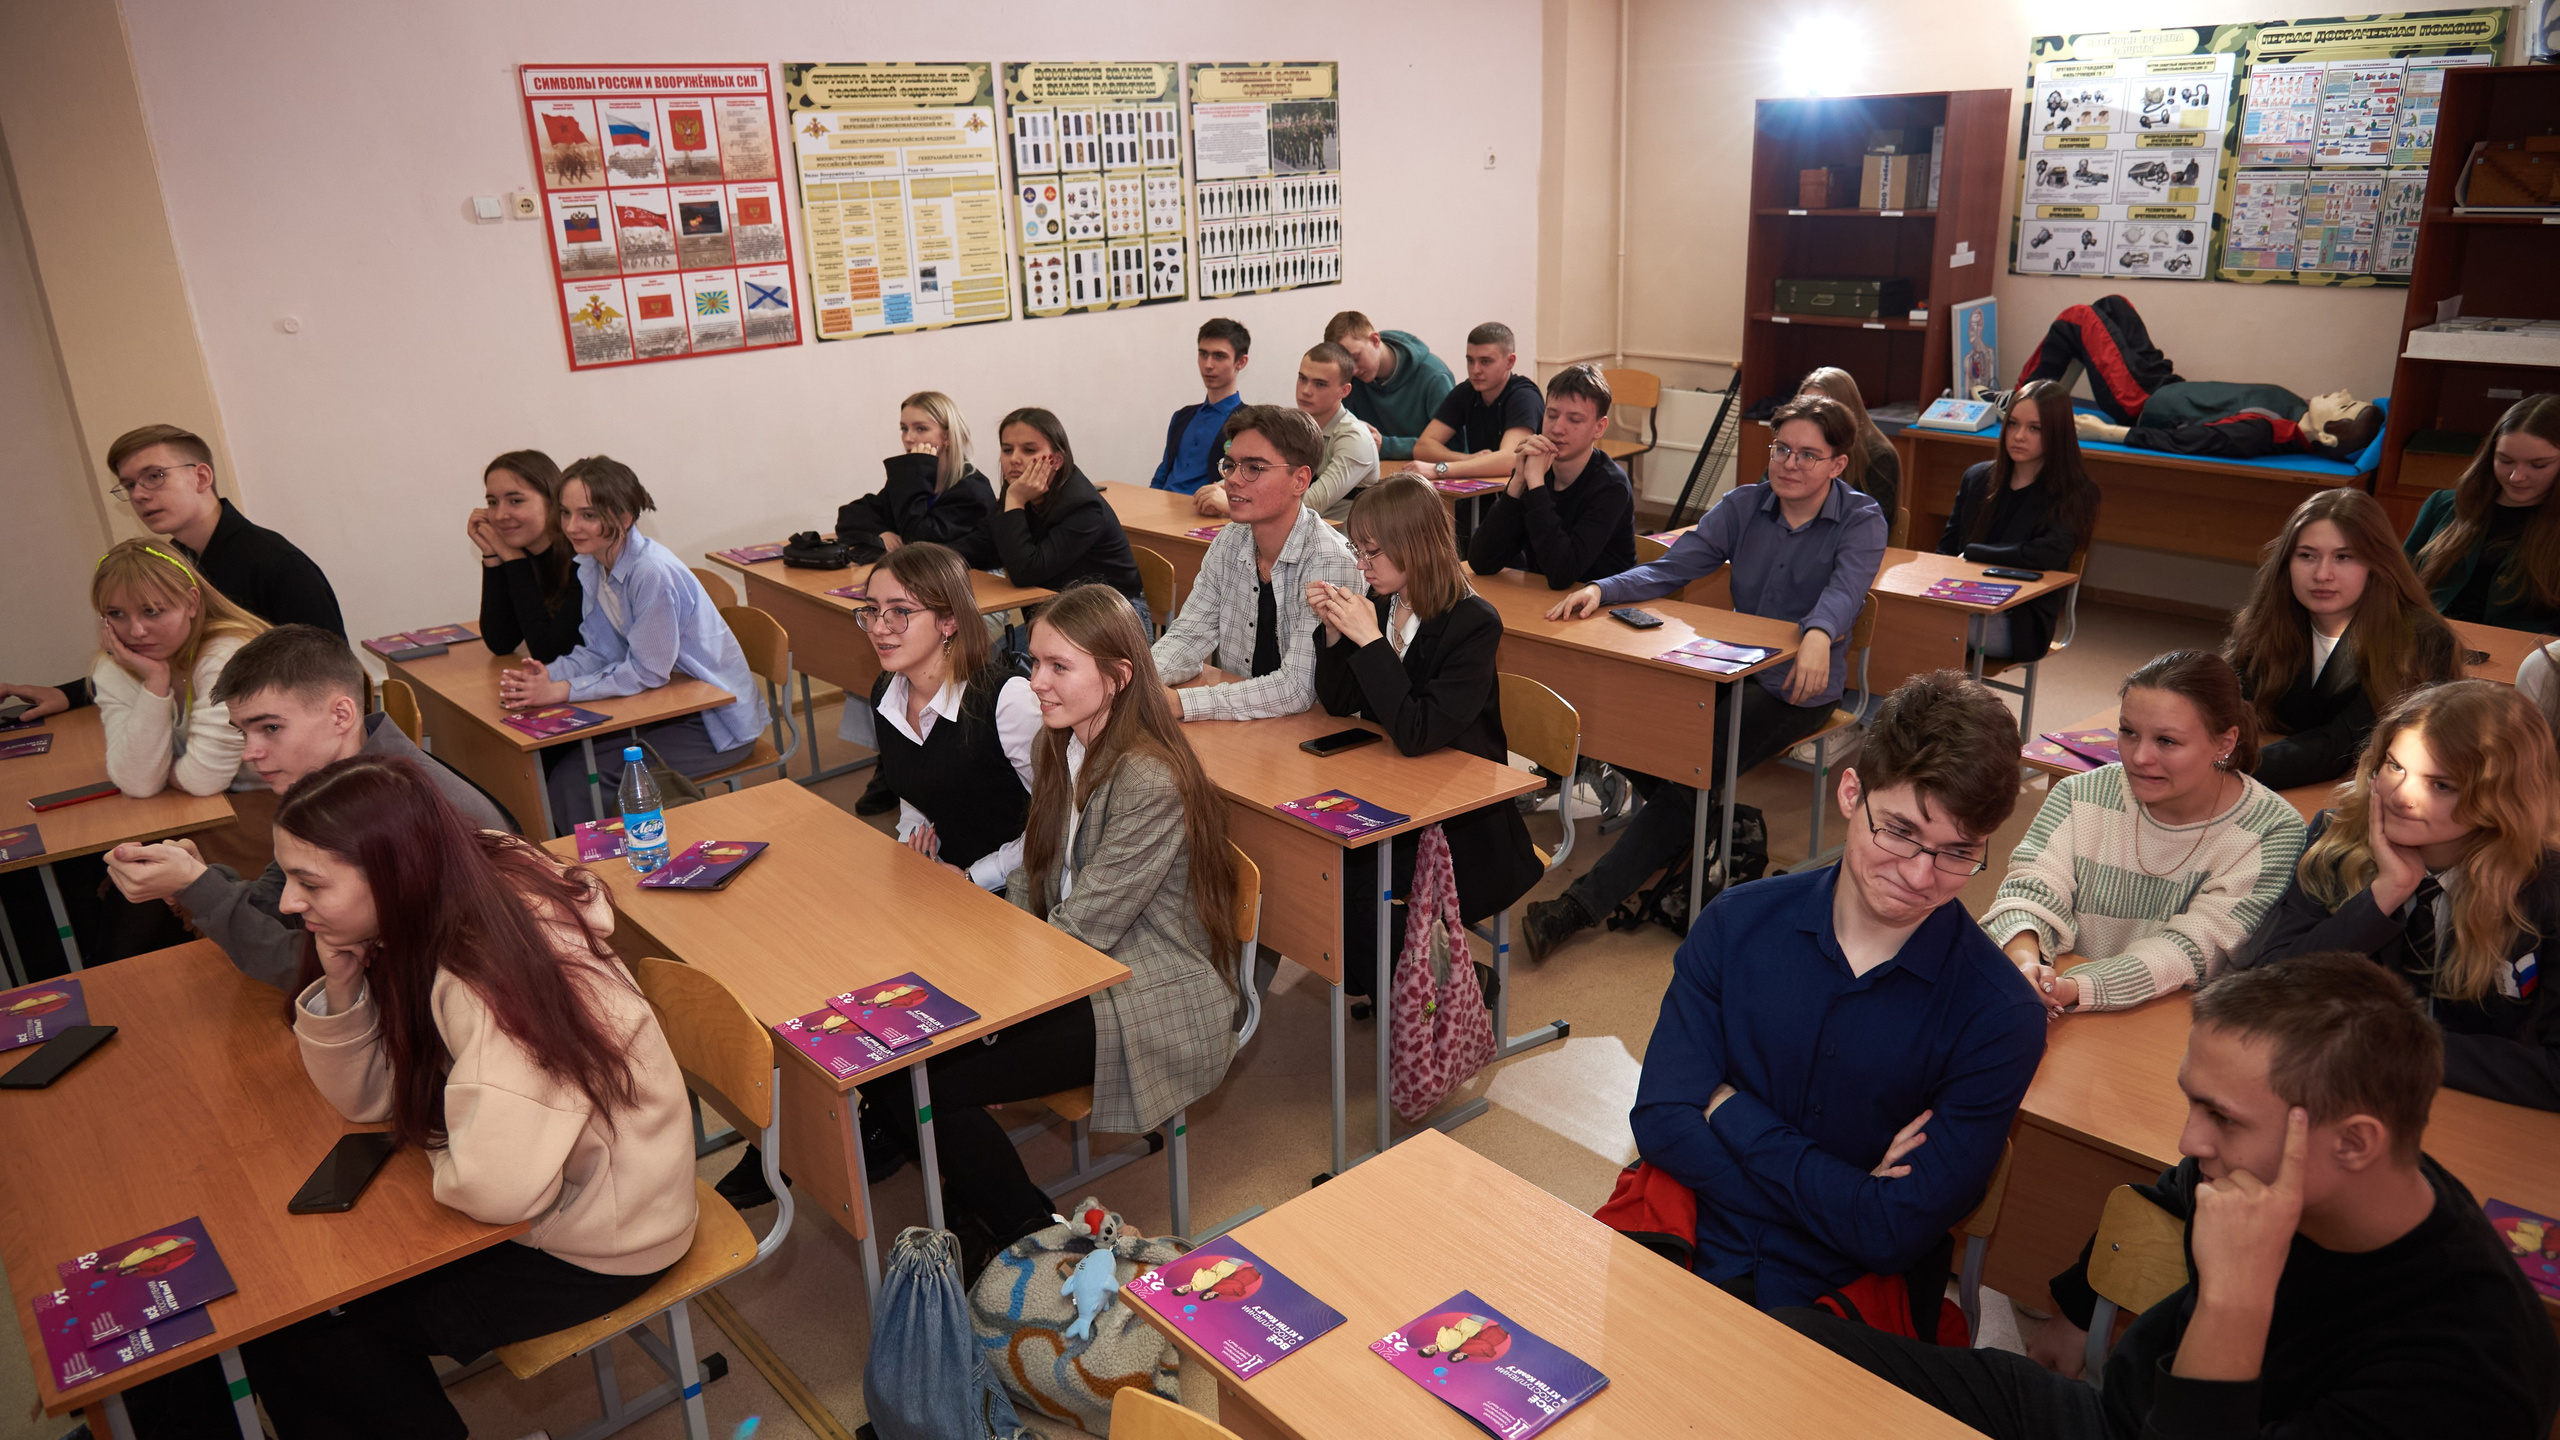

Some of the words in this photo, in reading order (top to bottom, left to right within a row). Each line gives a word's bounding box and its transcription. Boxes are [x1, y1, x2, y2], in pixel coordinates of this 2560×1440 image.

[2138, 33, 2184, 44] СРЕДСТВА
[2261, 31, 2312, 45] ПЕРВАЯ
[2314, 25, 2416, 43] ДОВРАЧЕБНАЯ
[2419, 21, 2490, 36] ПОМОЩЬ
[533, 76, 596, 91] СИМВОЛЫ
[598, 76, 643, 90] РОССИИ
[645, 76, 651, 88] И
[655, 74, 735, 89] ВООРУЖЁННЫХ
[736, 75, 758, 88] СИЛ
[811, 74, 869, 85] СТРУКТУРА
[950, 73, 971, 83] СИЛ
[1034, 67, 1102, 81] ВОИНСКИЕ
[1105, 67, 1153, 80] ЗВАНИЯ
[1274, 71, 1311, 82] ФОРМА
[1032, 83, 1043, 96] И
[1046, 83, 1090, 96] ЗНАКИ
[1093, 82, 1156, 95] РАЗЛИЧИЯ
[837, 992, 855, 1004] 23
[785, 1017, 803, 1030] 23
[77, 1252, 99, 1270] 23
[1128, 1280, 1155, 1299] 20
[1140, 1271, 1165, 1292] 23
[143, 1305, 160, 1320] ВСЁ
[1252, 1305, 1279, 1324] КемГУ
[1241, 1305, 1290, 1341] ПОСТУПЛЕНИИ
[1275, 1321, 1299, 1338] КГПИ
[1266, 1334, 1291, 1351] ВСЁ
[1370, 1339, 1400, 1361] 20
[1382, 1331, 1410, 1352] 23
[117, 1346, 135, 1363] ВСЁ
[1505, 1365, 1537, 1383] КемГУ
[1494, 1365, 1553, 1404] ПОСТУПЛЕНИИ
[1534, 1380, 1562, 1400] КГПИ
[1527, 1394, 1555, 1415] ВСЁ
